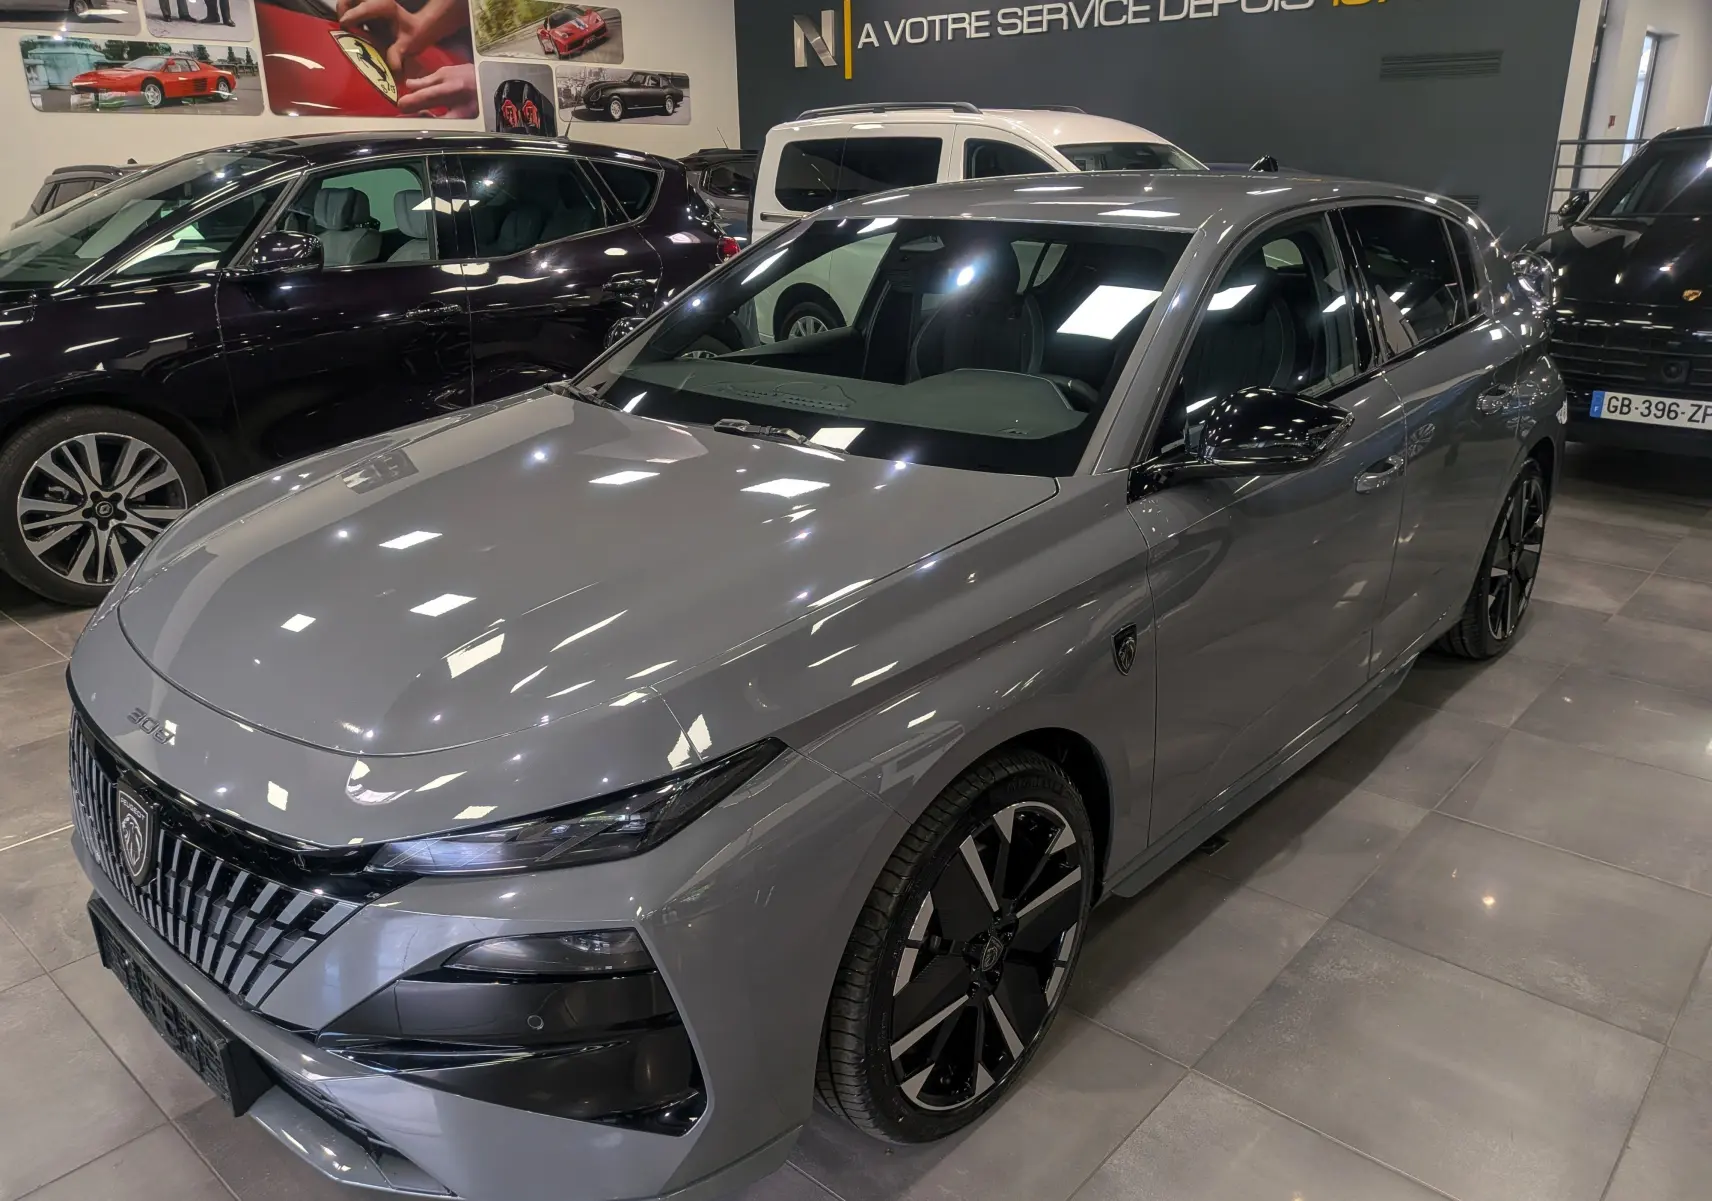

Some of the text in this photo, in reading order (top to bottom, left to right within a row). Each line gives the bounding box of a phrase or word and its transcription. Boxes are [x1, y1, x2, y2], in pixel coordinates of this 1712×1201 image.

[857, 22, 880, 49] A
[884, 10, 991, 46] VOTRE
[997, 0, 1150, 36] SERVICE
